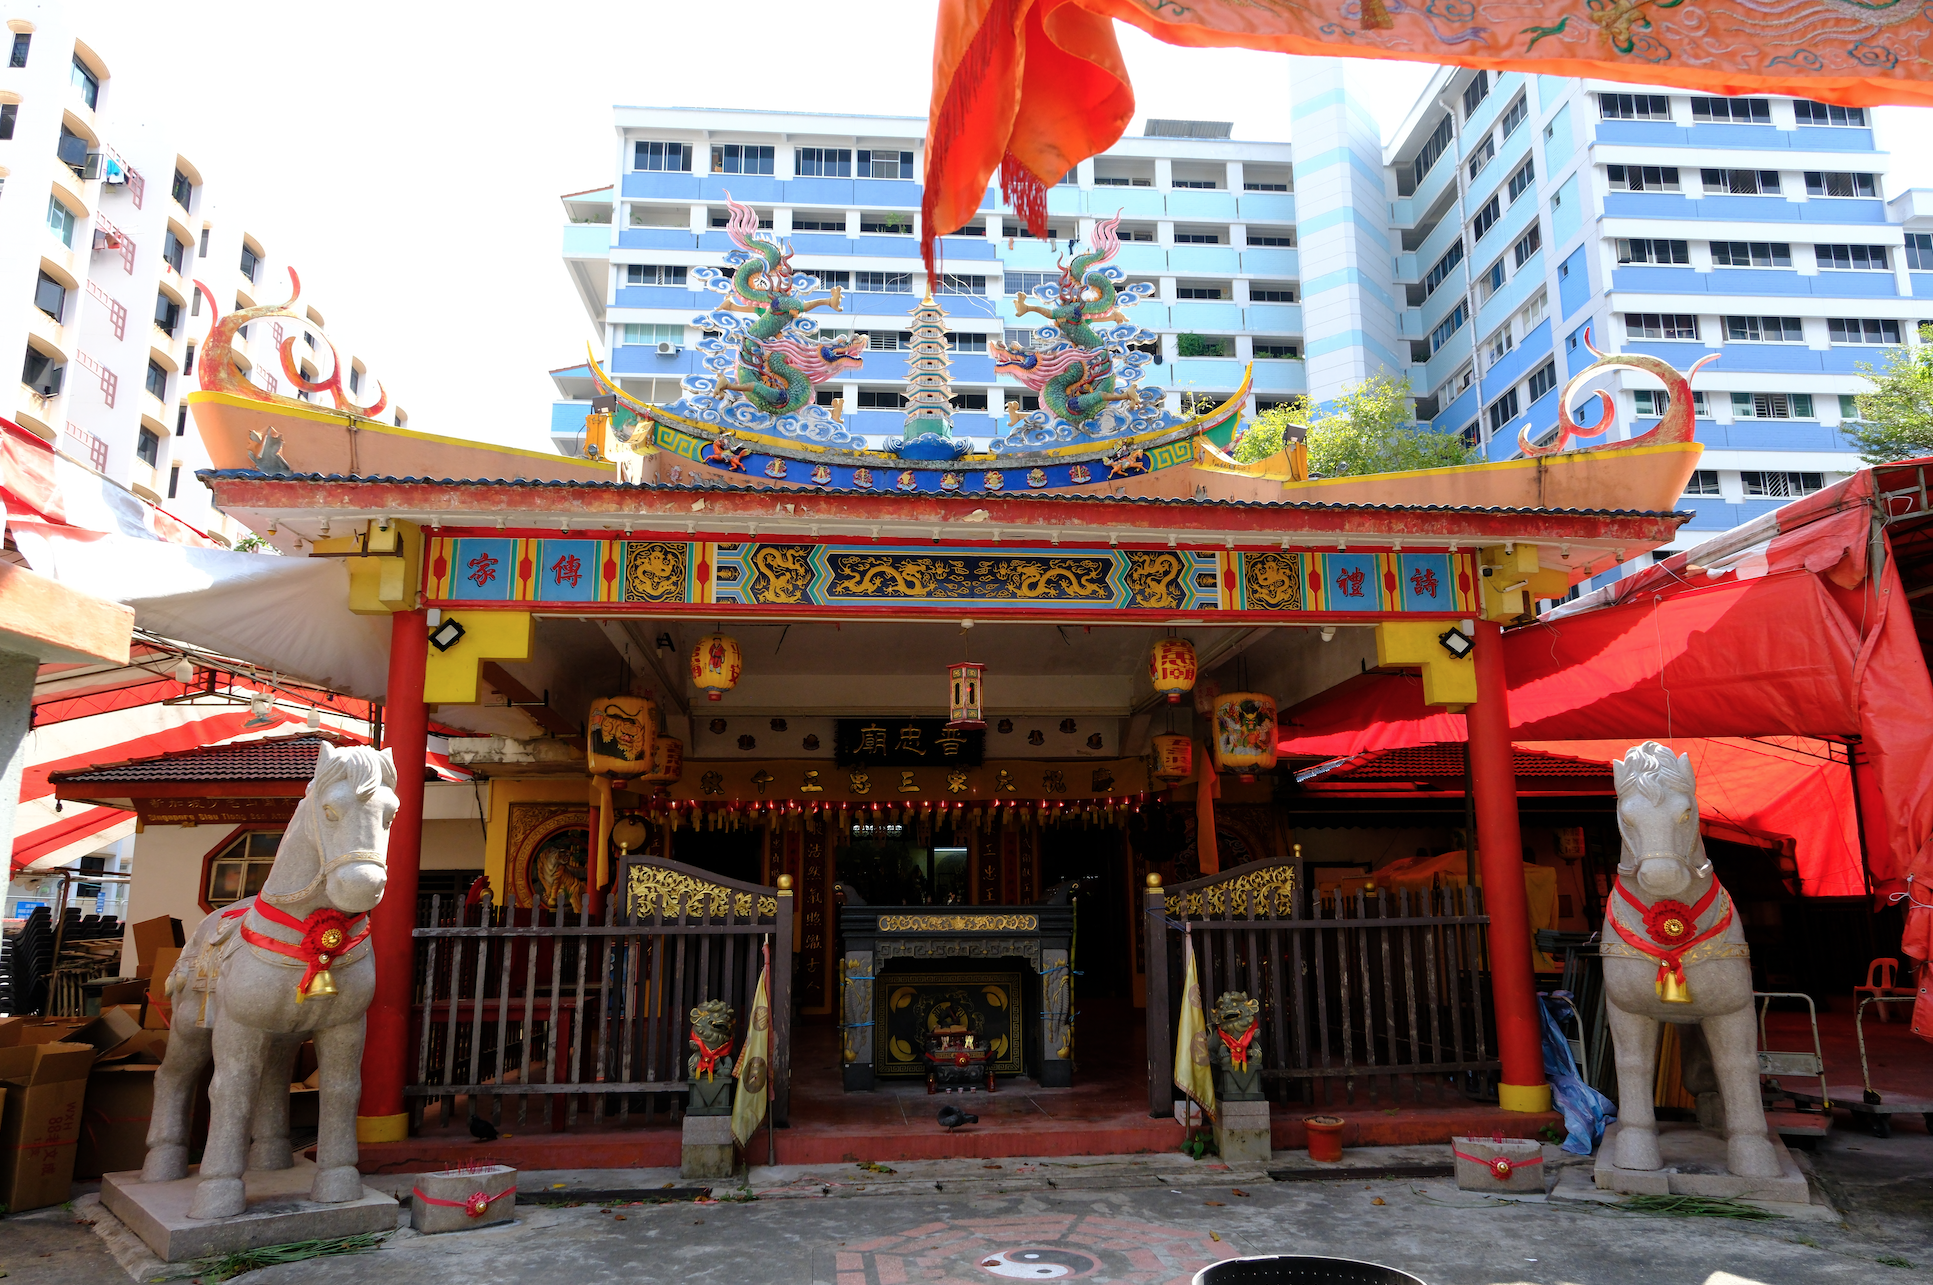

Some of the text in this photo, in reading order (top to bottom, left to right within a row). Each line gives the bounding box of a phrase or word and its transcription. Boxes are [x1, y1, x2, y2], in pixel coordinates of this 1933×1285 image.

[467, 552, 1440, 598] 詩 禮 傳 家
[729, 641, 742, 685] 平安
[853, 723, 968, 757] 普忠廟
[147, 813, 195, 822] Singapore
[220, 812, 247, 821] Tiong
[271, 812, 294, 820] Athl
[64, 1102, 76, 1130] WXH
